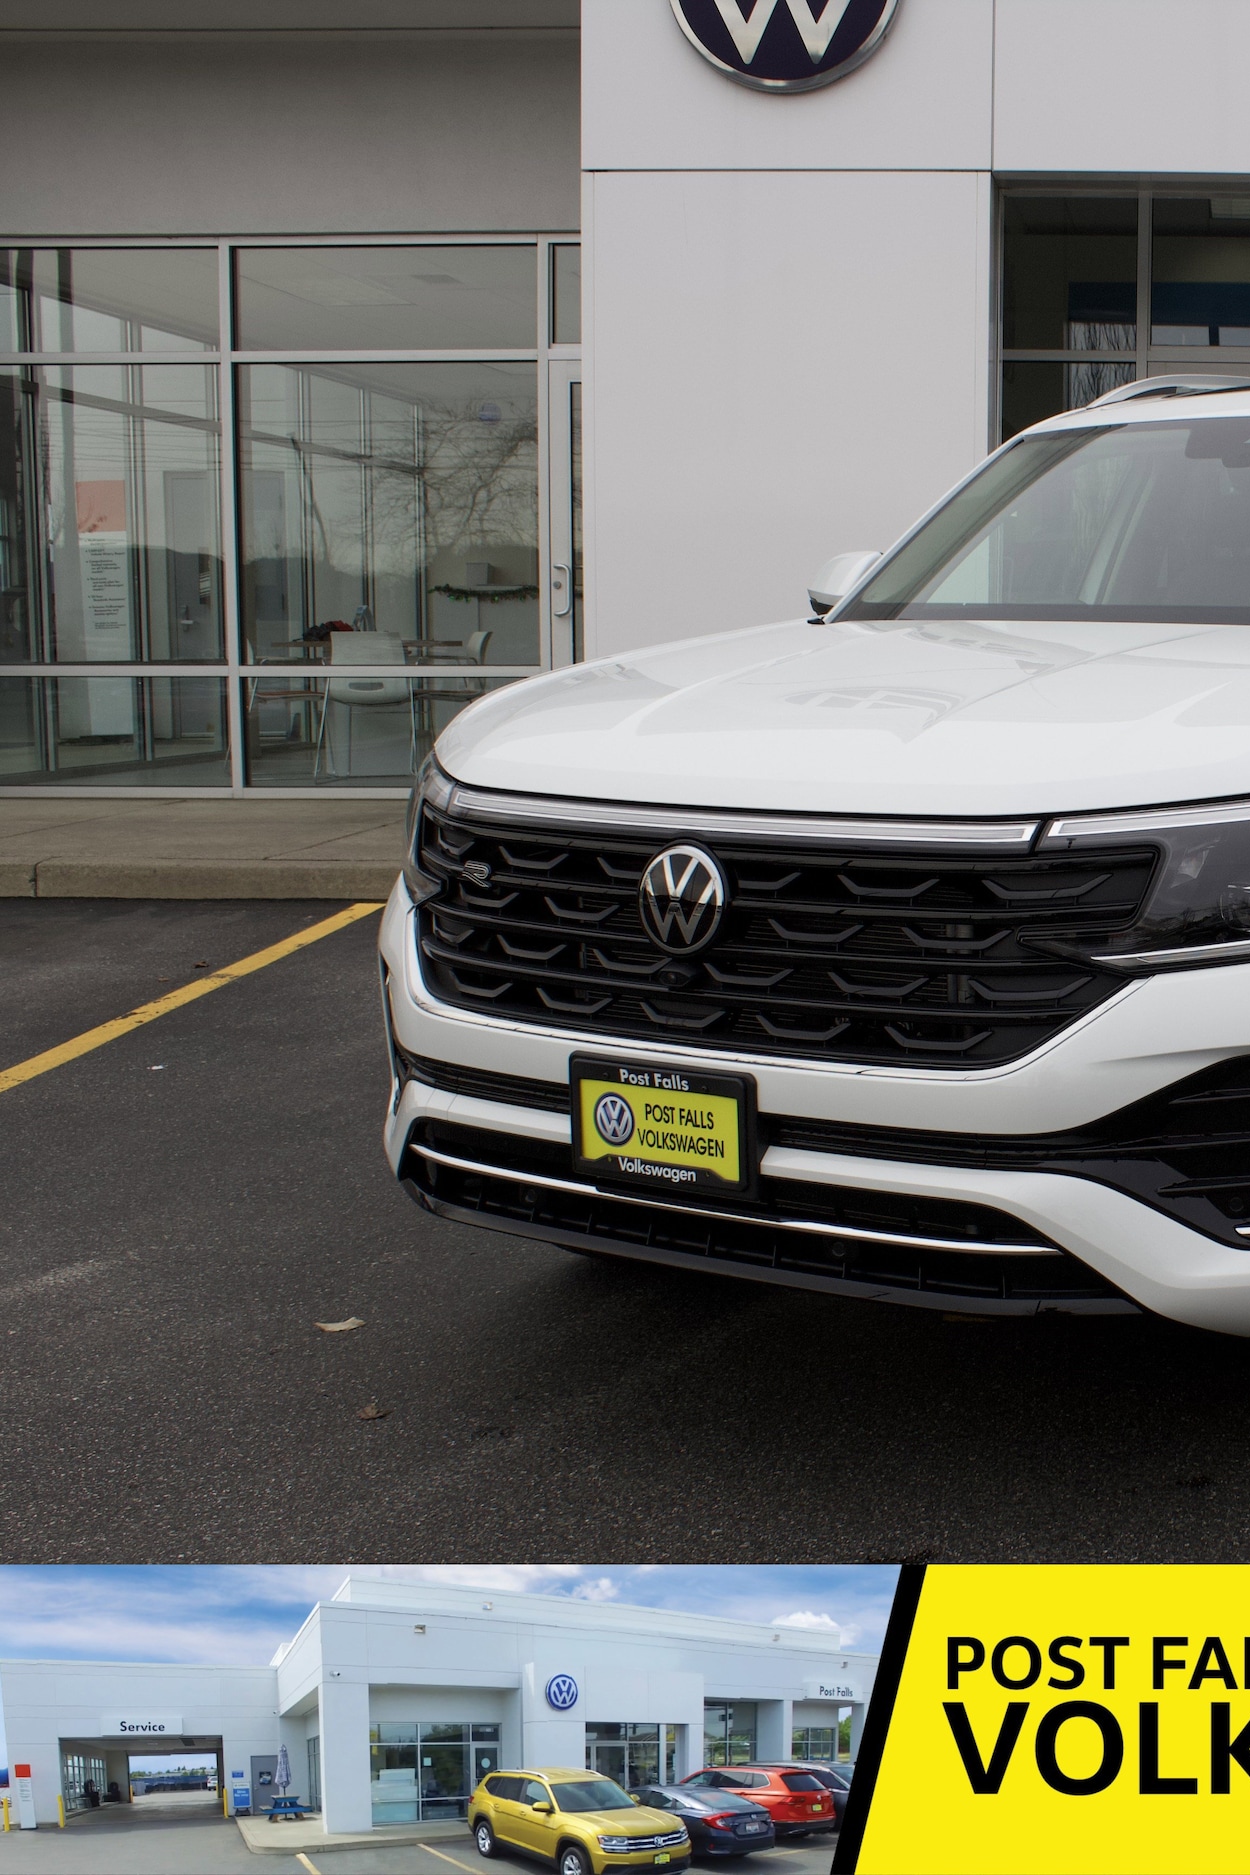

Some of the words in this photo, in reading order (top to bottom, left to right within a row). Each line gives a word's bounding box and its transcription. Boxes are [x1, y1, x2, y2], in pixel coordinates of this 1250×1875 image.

[619, 1068, 650, 1083] Post
[653, 1072, 690, 1092] Falls
[644, 1103, 675, 1125] POST
[679, 1107, 714, 1130] FALLS
[637, 1128, 725, 1158] VOLKSWAGEN
[618, 1156, 697, 1183] Volkswagen
